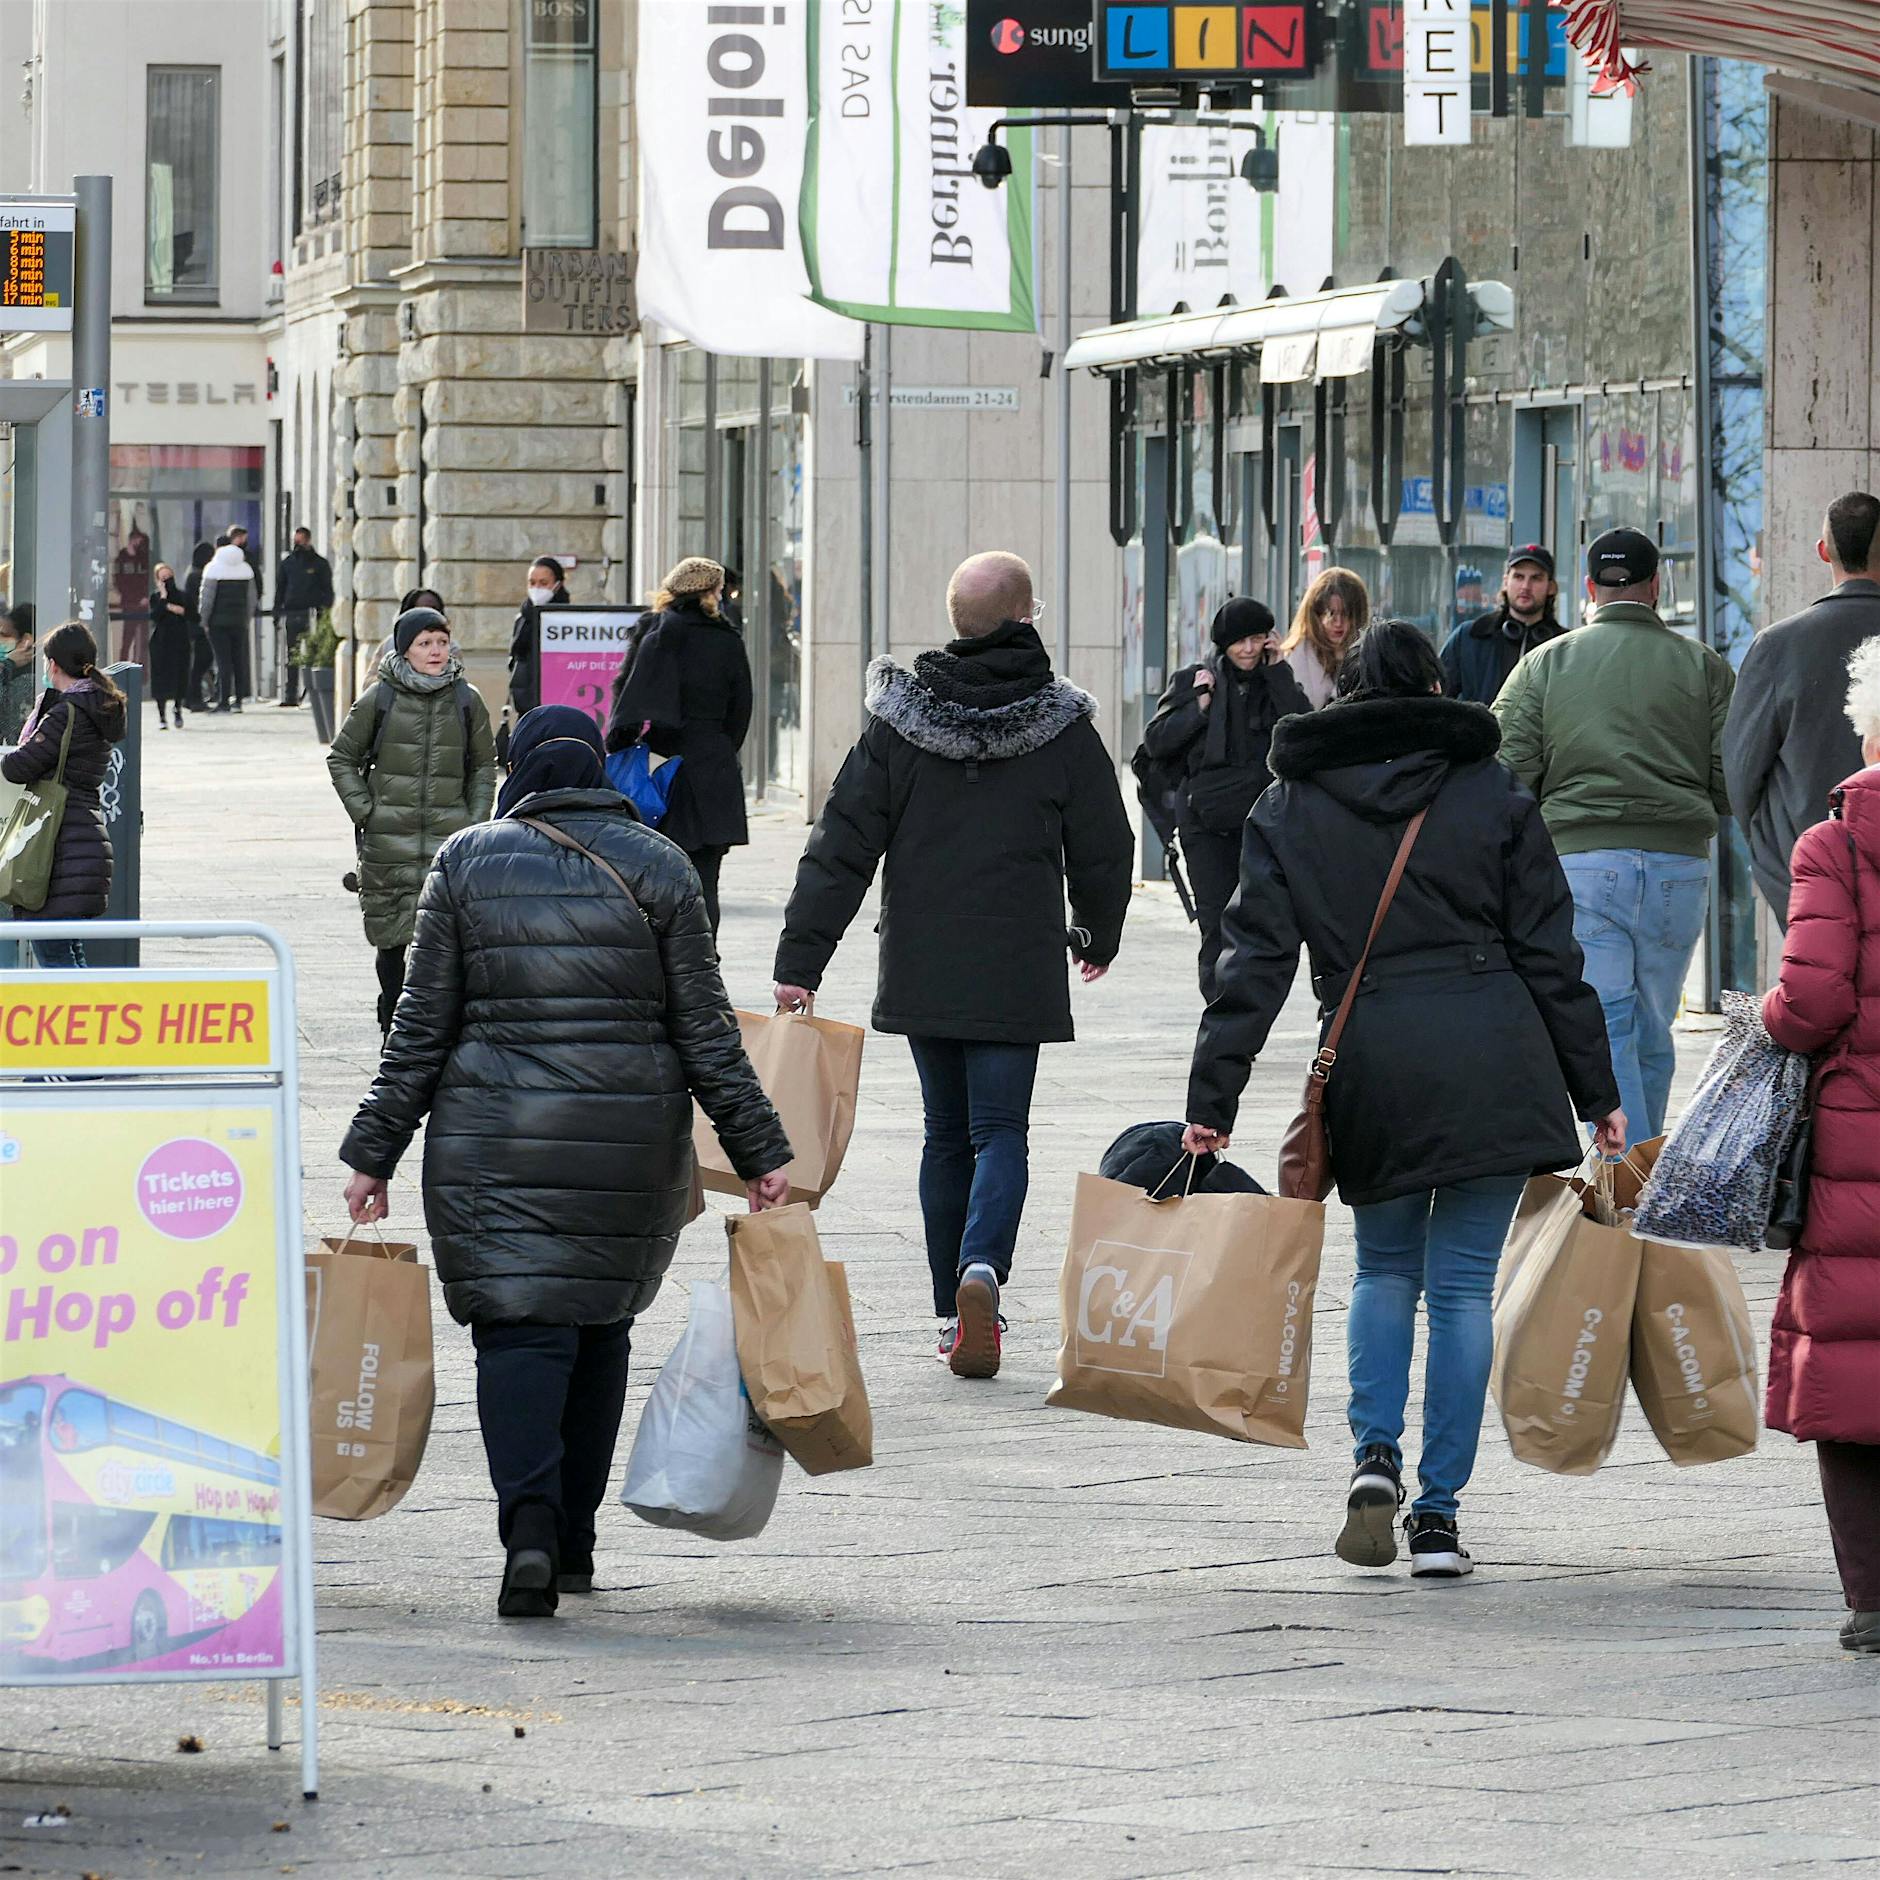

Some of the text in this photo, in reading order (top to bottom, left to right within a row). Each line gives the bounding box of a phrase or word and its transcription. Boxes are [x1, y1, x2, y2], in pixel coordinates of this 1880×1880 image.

[534, 1, 586, 17] BOSS
[1423, 0, 1458, 135] ET
[33, 216, 45, 228] in
[10, 230, 44, 243] 5 min
[10, 243, 44, 255] 6 min
[10, 255, 44, 268] 8 min
[527, 251, 627, 277] URBAN
[10, 267, 43, 280] 9 min
[3, 280, 43, 292] 16 min
[528, 278, 632, 303] OUTFIT
[3, 292, 43, 305] 17 min
[563, 305, 632, 330] TERS
[115, 382, 256, 404] TESLA
[975, 392, 1013, 405] 21-24
[567, 662, 587, 671] AUF
[590, 662, 606, 671] DIE
[157, 1002, 255, 1044] HIER
[144, 1168, 235, 1194] Tickets
[37, 1225, 120, 1273] on
[4, 1265, 251, 1349] Hop off
[1077, 1265, 1175, 1351] C&A
[1277, 1279, 1301, 1377] C-A.COM
[354, 1342, 380, 1432] FOLLOW
[336, 1400, 356, 1429] US
[221, 1653, 234, 1664] in
[236, 1653, 274, 1664] Berlin
